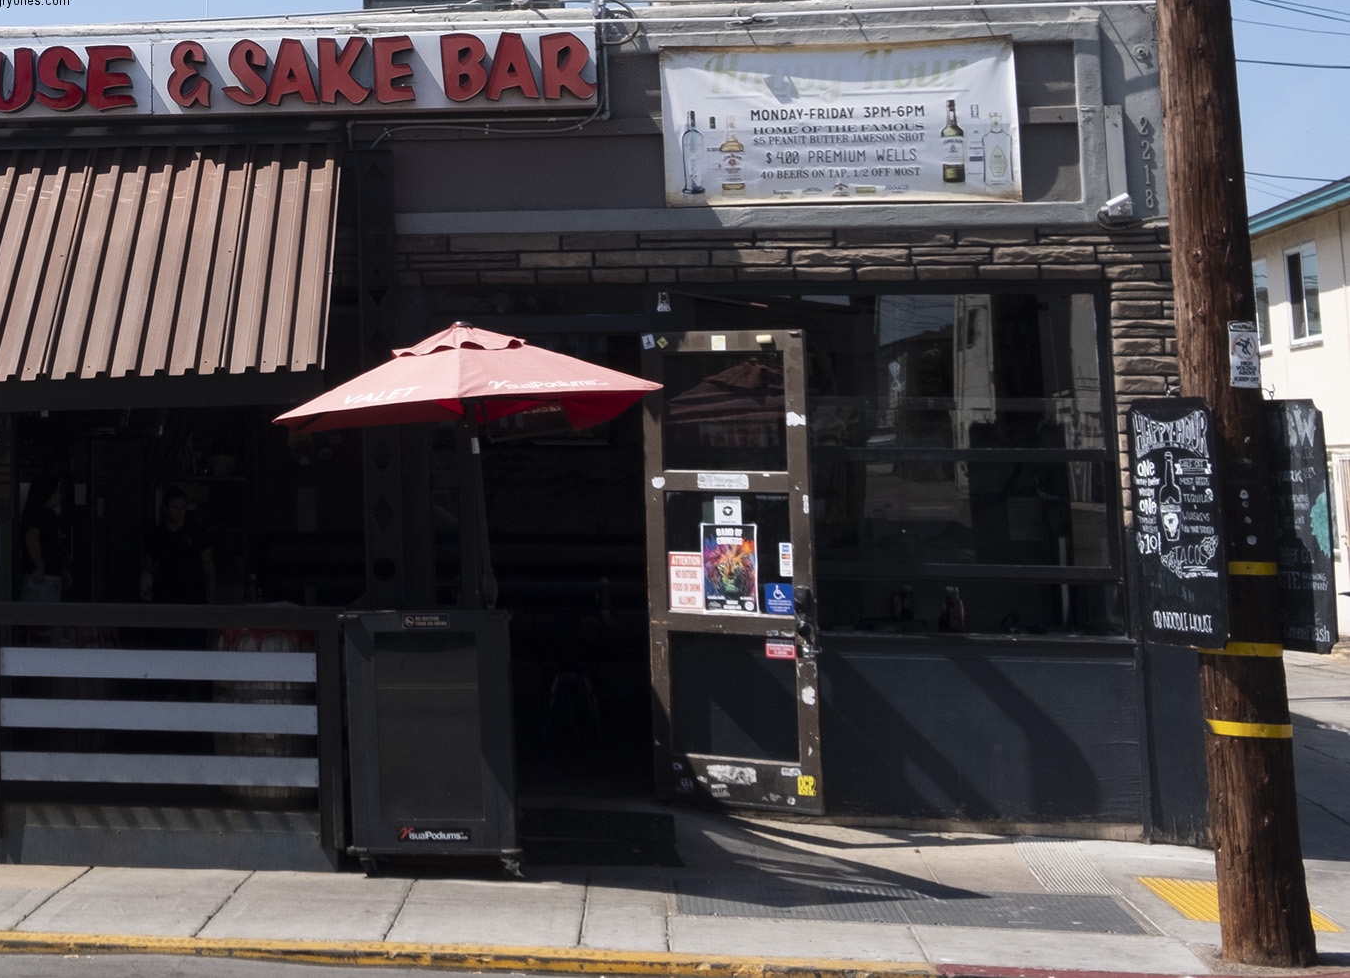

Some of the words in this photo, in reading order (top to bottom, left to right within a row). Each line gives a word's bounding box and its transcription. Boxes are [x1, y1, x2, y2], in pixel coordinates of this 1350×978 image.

[167, 40, 212, 108] &
[222, 35, 416, 106] SAKE
[440, 32, 598, 103] BAR
[859, 49, 969, 90] Hour
[750, 107, 855, 121] MONDAY-FRIDAY
[863, 105, 925, 119] 3PM-6PM
[753, 126, 799, 135] HOME
[801, 125, 823, 134] OF
[824, 124, 858, 134] THE
[861, 123, 925, 133] FAMOUS
[753, 136, 766, 146] $5
[769, 135, 807, 145] PEANUT
[810, 134, 849, 144] BUTTER
[852, 133, 896, 143] JAMESON
[898, 132, 925, 142] SHOT
[808, 150, 867, 164] PREMIUM
[876, 148, 918, 162] WELLS
[1138, 117, 1154, 209] 2218
[760, 170, 774, 180] 40
[776, 170, 809, 180] BEERS
[811, 169, 825, 179] ON
[854, 168, 869, 178] 1/2
[871, 168, 891, 177] OFF
[893, 167, 921, 177] MOST
[343, 385, 423, 406] VALET
[671, 555, 701, 567] ATTENTION
[400, 826, 461, 840] VisualPodiums
